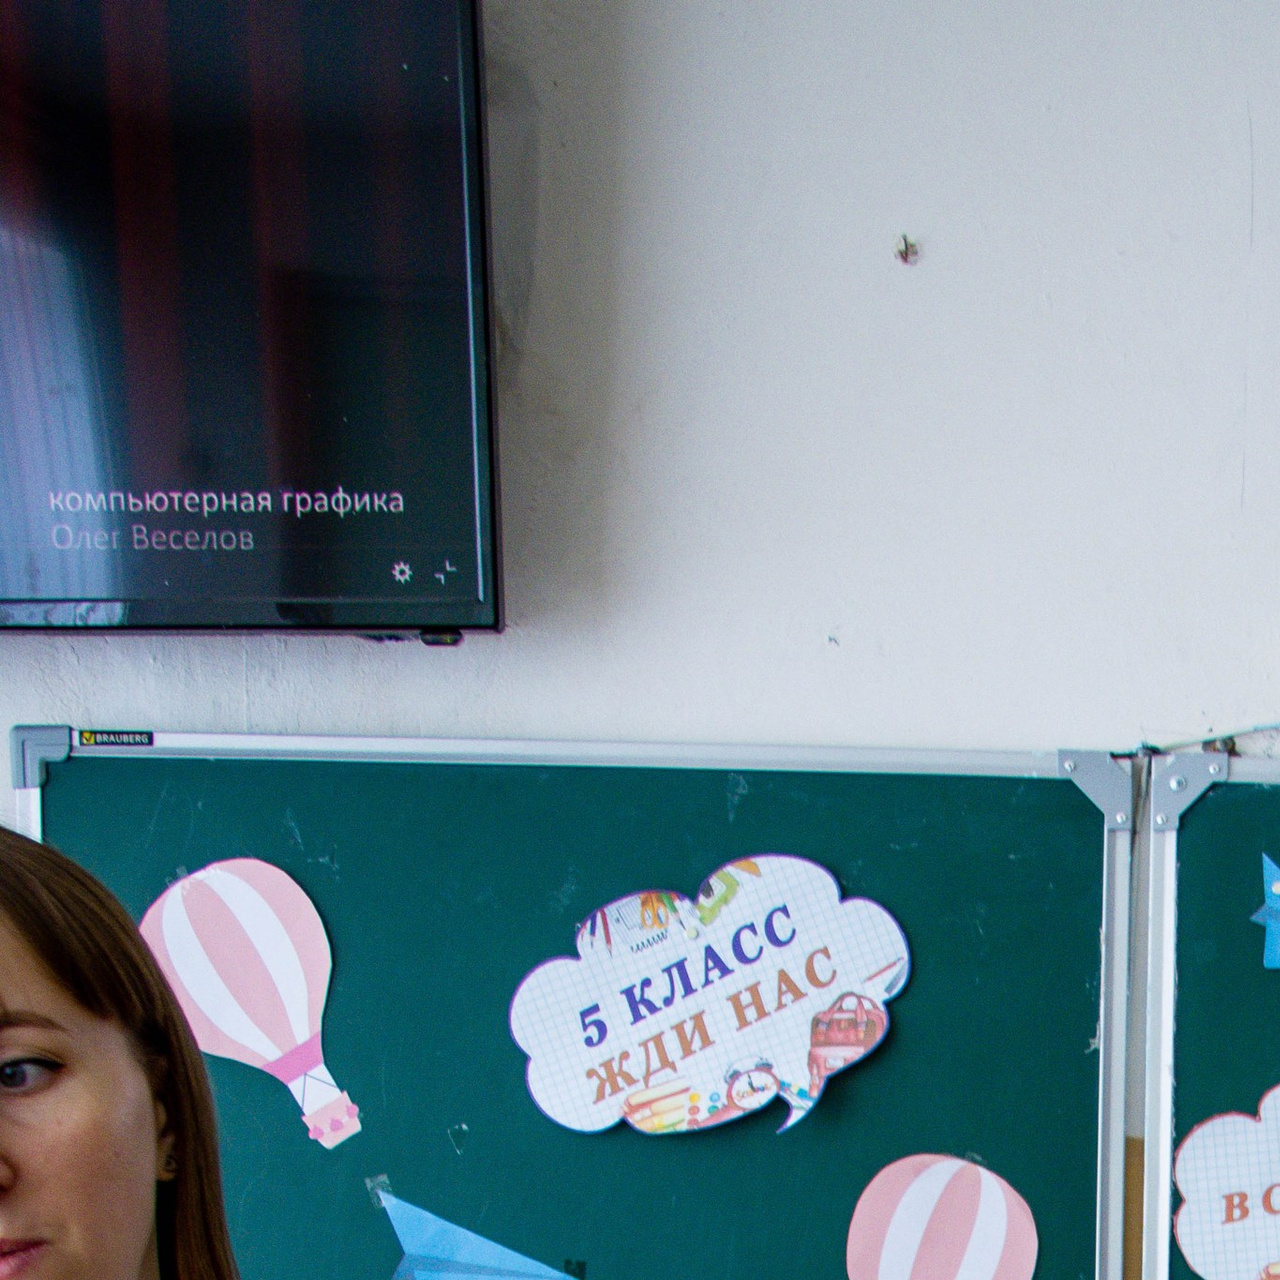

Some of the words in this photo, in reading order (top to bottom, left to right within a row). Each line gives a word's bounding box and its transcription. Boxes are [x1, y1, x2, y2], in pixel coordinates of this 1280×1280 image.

[49, 489, 273, 519] компьютерная
[281, 485, 405, 519] графика
[52, 523, 122, 551] Олег
[130, 524, 256, 551] Веселов
[95, 733, 150, 745] BRAUBERG
[578, 1003, 610, 1049] 5
[617, 904, 799, 1030] КЛАСС
[584, 1009, 718, 1107] ЖДИ
[725, 946, 840, 1033] НАС
[1220, 1191, 1251, 1225] В
